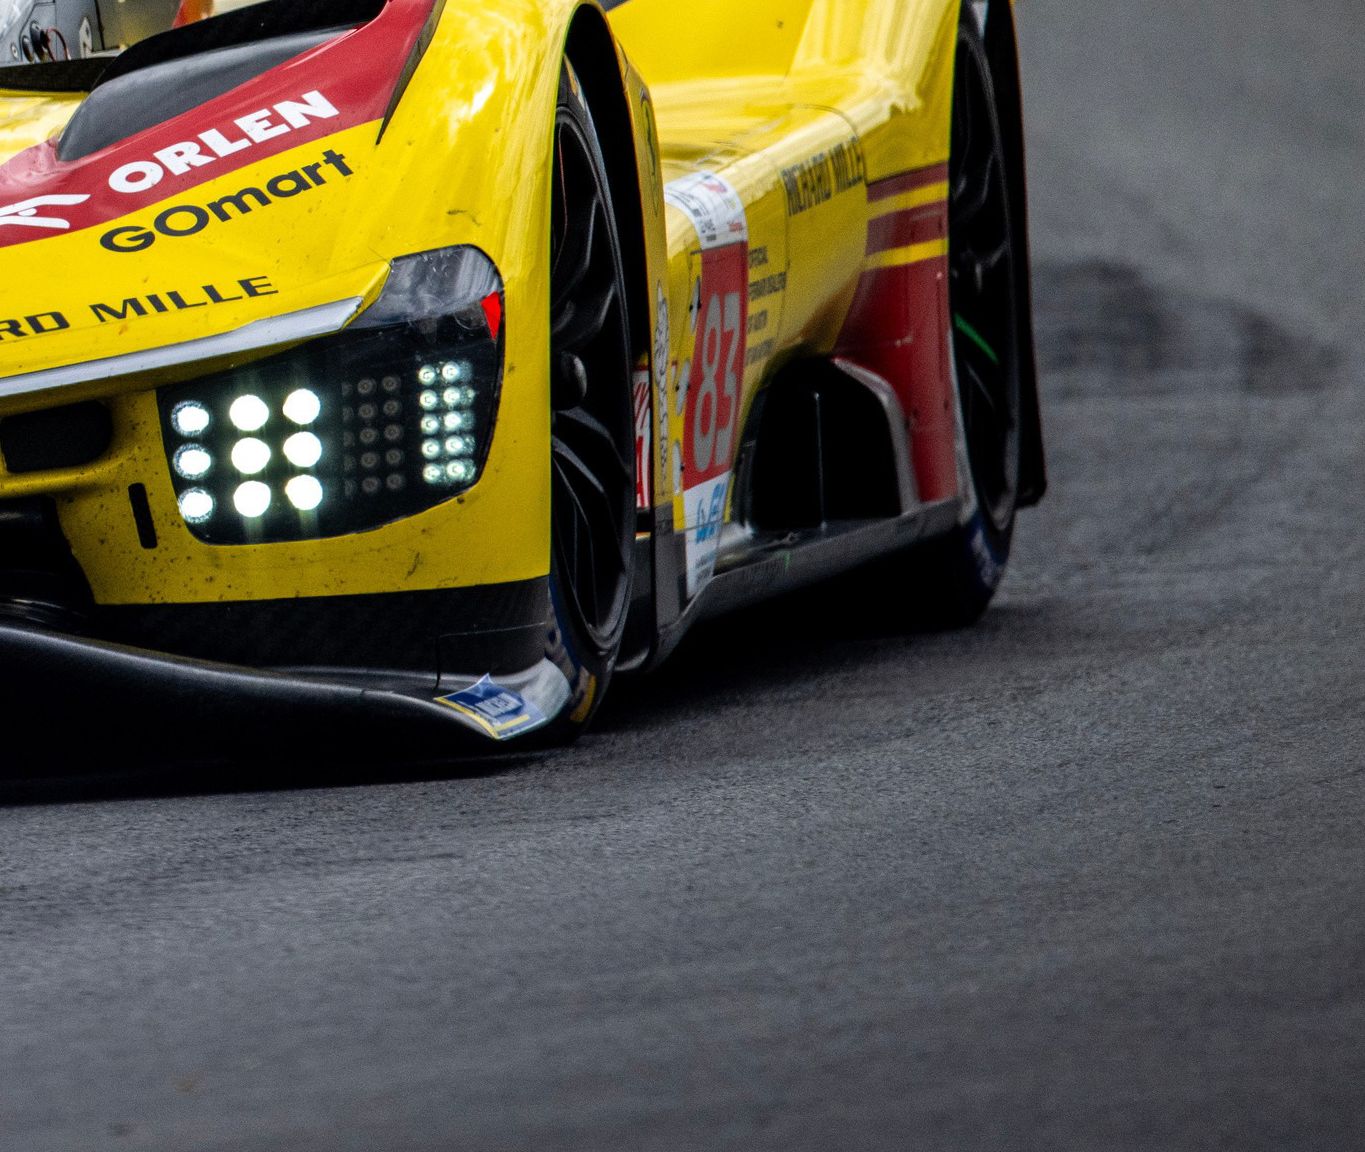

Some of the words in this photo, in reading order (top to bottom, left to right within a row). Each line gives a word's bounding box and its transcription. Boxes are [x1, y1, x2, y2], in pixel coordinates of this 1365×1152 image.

[108, 90, 340, 194] ORLEN
[100, 149, 355, 253] GOmart
[89, 276, 279, 324] MILLE
[693, 291, 741, 473] 83
